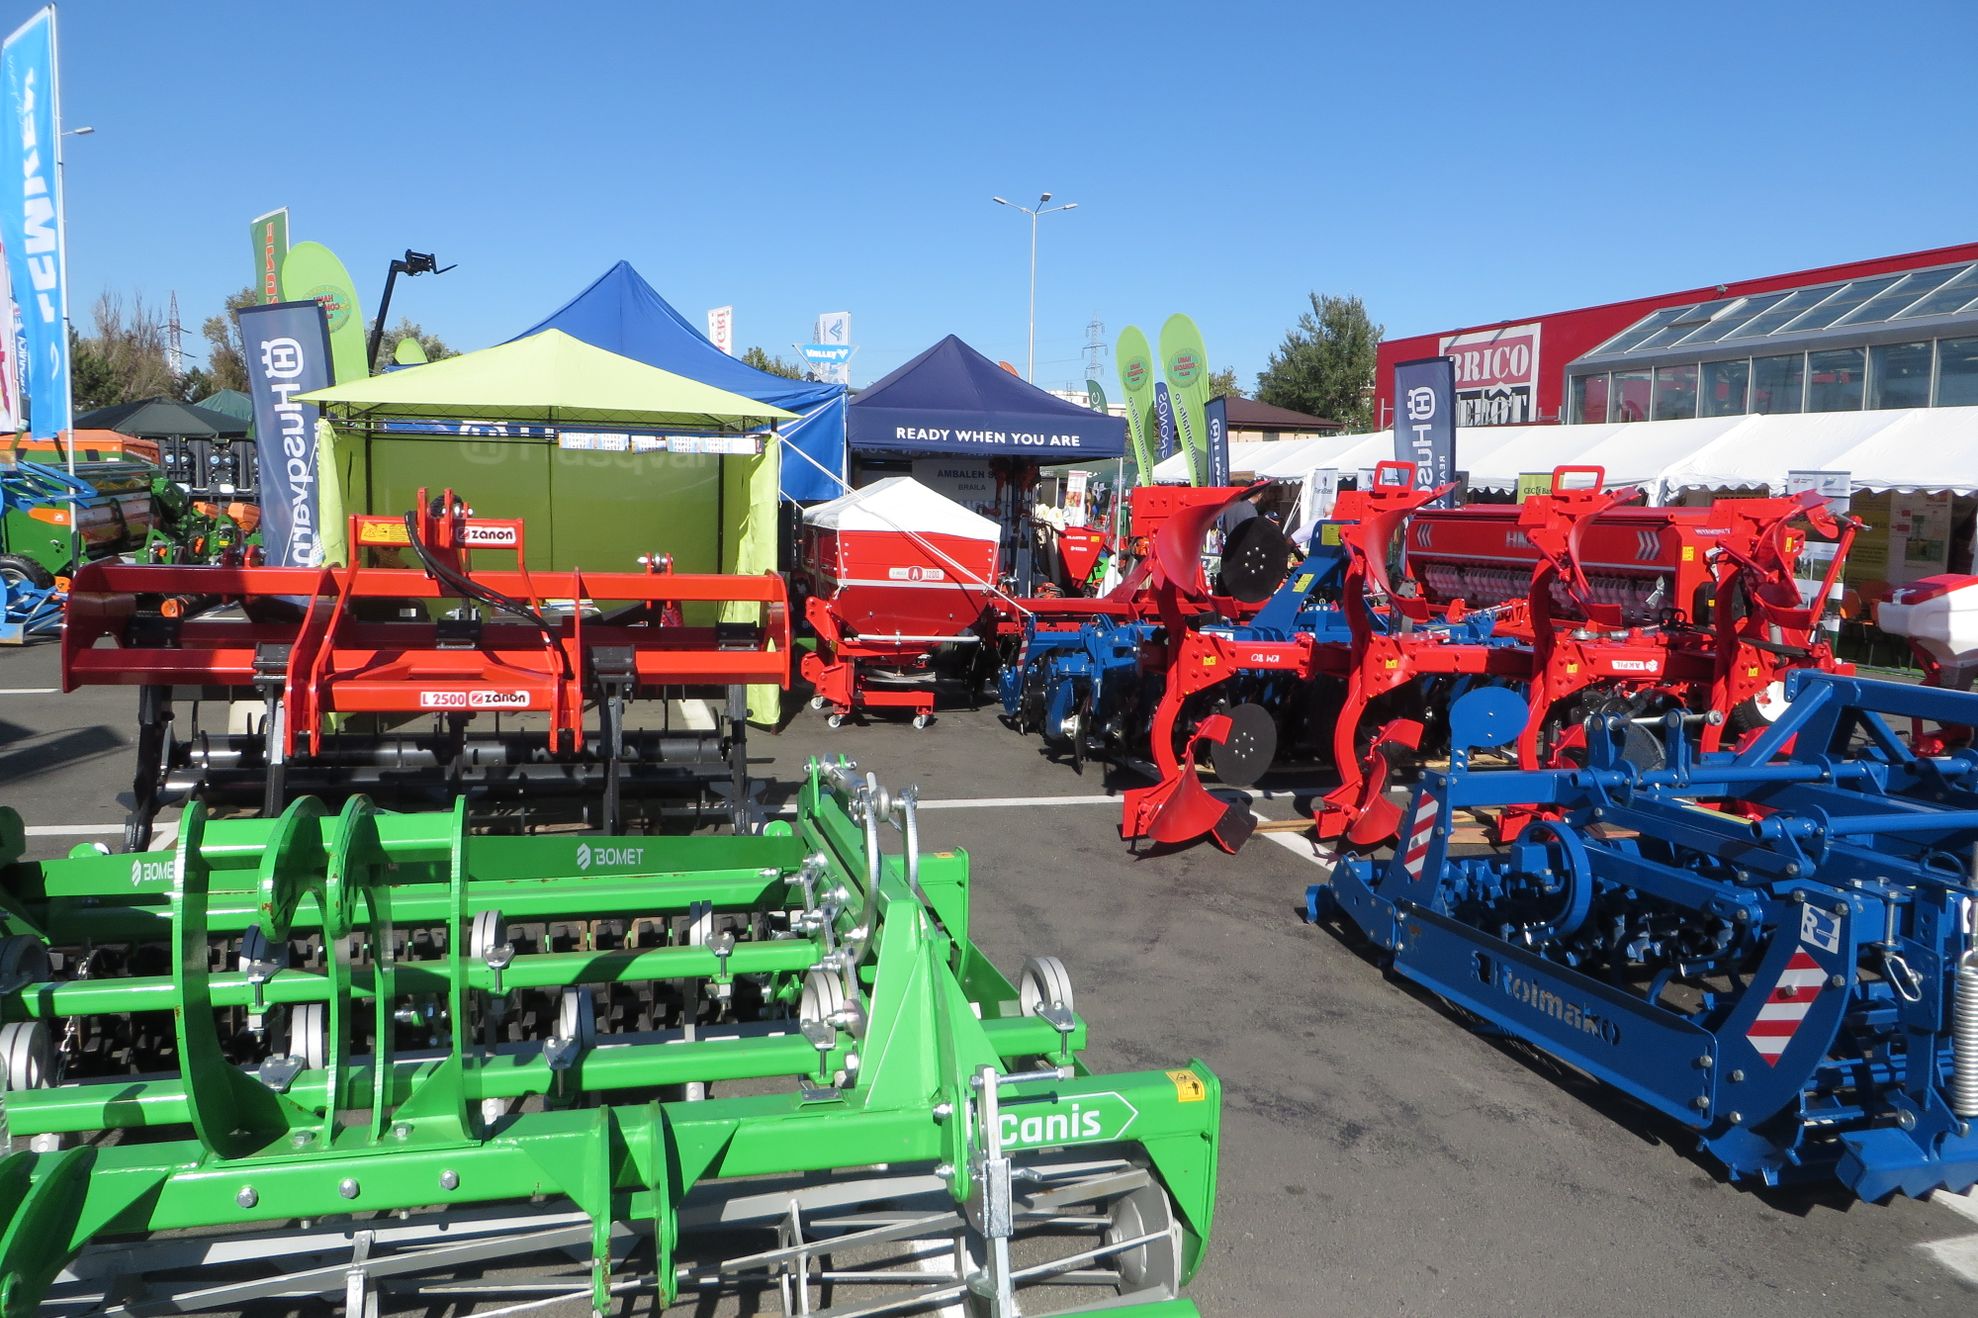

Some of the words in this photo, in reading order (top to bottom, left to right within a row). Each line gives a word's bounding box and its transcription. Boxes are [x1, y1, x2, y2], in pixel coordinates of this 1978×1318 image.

[1457, 395, 1528, 427] EPOT
[896, 427, 950, 442] READY
[955, 430, 1006, 444] WHEN
[1011, 432, 1045, 447] YOU
[1050, 434, 1081, 447] ARE
[472, 529, 513, 540] zanon
[422, 694, 428, 705] L
[433, 693, 465, 705] 2500
[485, 693, 526, 704] zanon
[594, 847, 644, 865] BOMET
[143, 861, 174, 881] BOME
[1000, 1103, 1101, 1146] Canis
